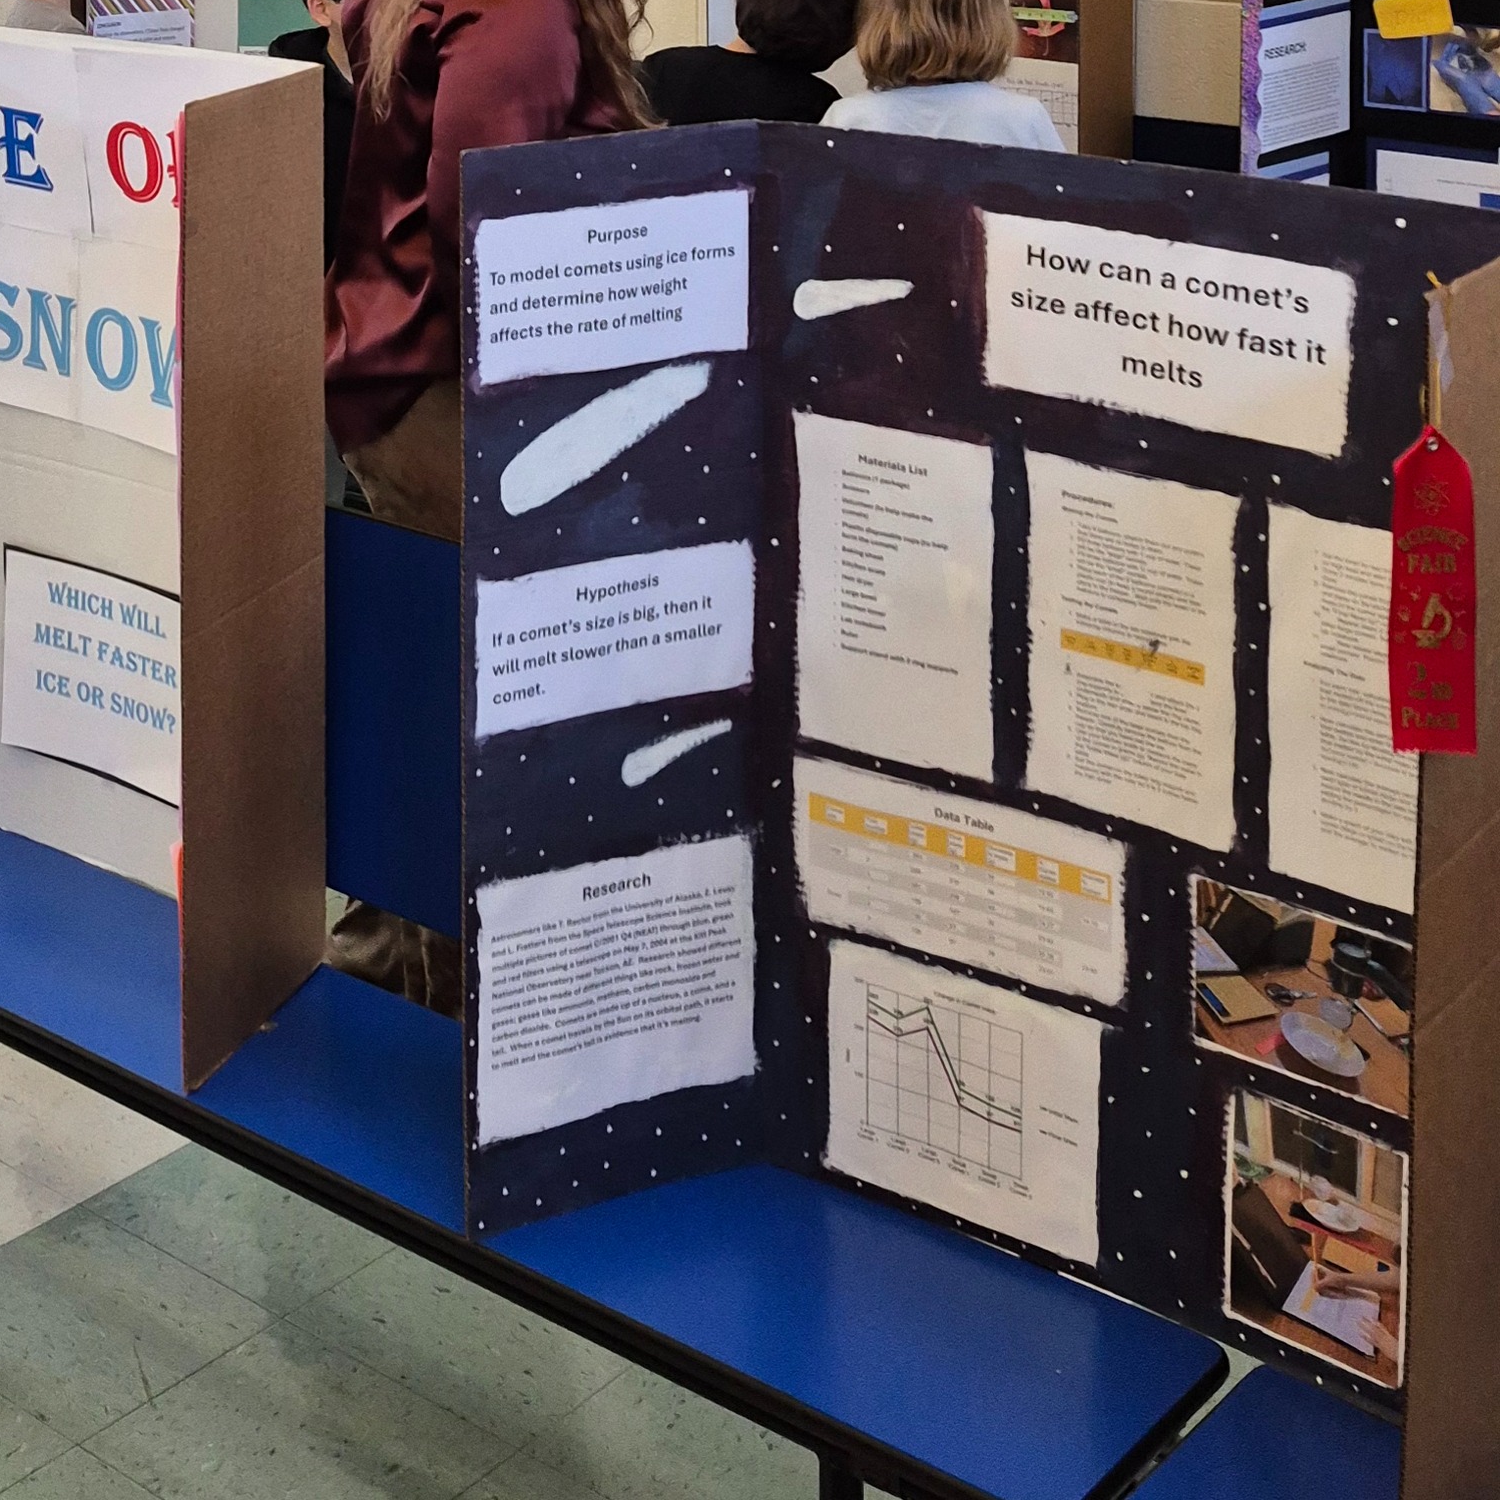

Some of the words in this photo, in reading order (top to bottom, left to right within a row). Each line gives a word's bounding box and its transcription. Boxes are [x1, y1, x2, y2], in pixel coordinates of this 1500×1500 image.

[587, 224, 649, 245] Purpose
[490, 271, 506, 287] To
[510, 264, 560, 285] model
[563, 258, 623, 278] comets
[625, 251, 664, 272] using
[665, 249, 688, 264] ice
[690, 243, 736, 263] forms
[1025, 244, 1091, 276] How
[1098, 260, 1152, 286] can
[1160, 271, 1177, 291] a
[1185, 273, 1310, 315] comet's
[490, 299, 518, 315] and
[522, 289, 604, 312] determine
[608, 285, 638, 302] how
[641, 275, 688, 297] weight
[490, 325, 543, 345] affects
[547, 320, 574, 336] the
[577, 318, 609, 334] rate
[612, 314, 627, 330] of
[629, 307, 683, 328] melting
[1010, 288, 1067, 316] size
[1073, 299, 1162, 334] affect
[1167, 312, 1230, 348] how
[1235, 327, 1298, 361] fast
[1304, 340, 1328, 367] it
[1121, 354, 1204, 390] melts
[857, 453, 908, 475] Materials
[908, 465, 928, 477] List
[1407, 553, 1457, 574] FAIR
[575, 574, 660, 603] Hypothesis
[47, 581, 114, 621] WHICH
[119, 602, 167, 638] WILL
[34, 622, 92, 657] MELT
[97, 639, 178, 689] FASTER
[35, 669, 71, 698] ICE
[76, 681, 106, 709] OR
[110, 691, 176, 734] SNOW?
[1401, 706, 1460, 730] PLACE
[934, 806, 961, 825] Data
[964, 815, 995, 833] Table
[583, 873, 651, 901] Research
